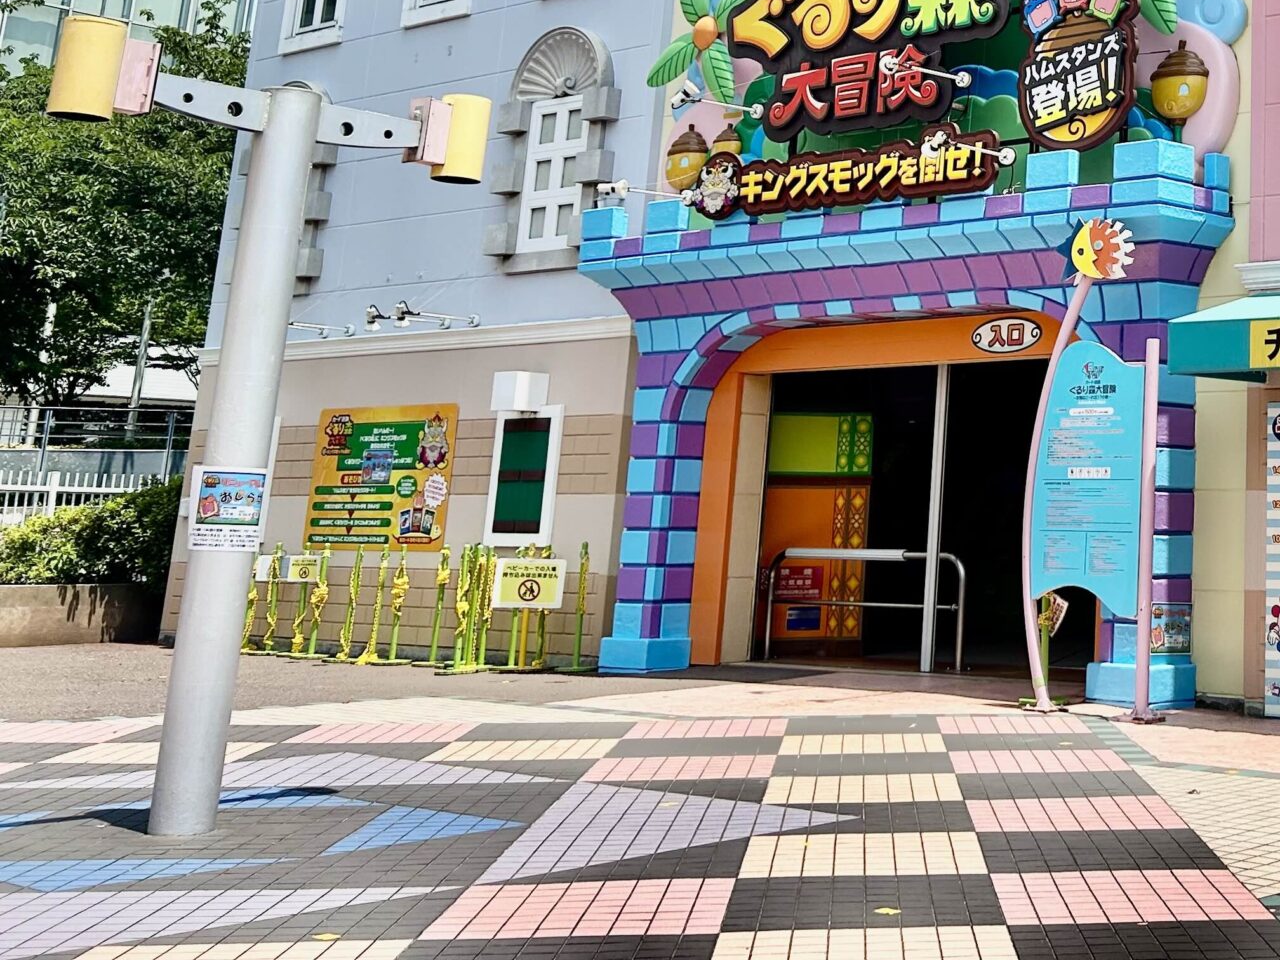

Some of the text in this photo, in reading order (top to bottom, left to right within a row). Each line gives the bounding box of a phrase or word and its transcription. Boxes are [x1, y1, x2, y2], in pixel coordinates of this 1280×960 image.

[769, 43, 940, 127] 大冒険
[1024, 31, 1120, 85] ハムスタンズ
[1031, 56, 1117, 127] 登場!
[988, 323, 1025, 347] 入口
